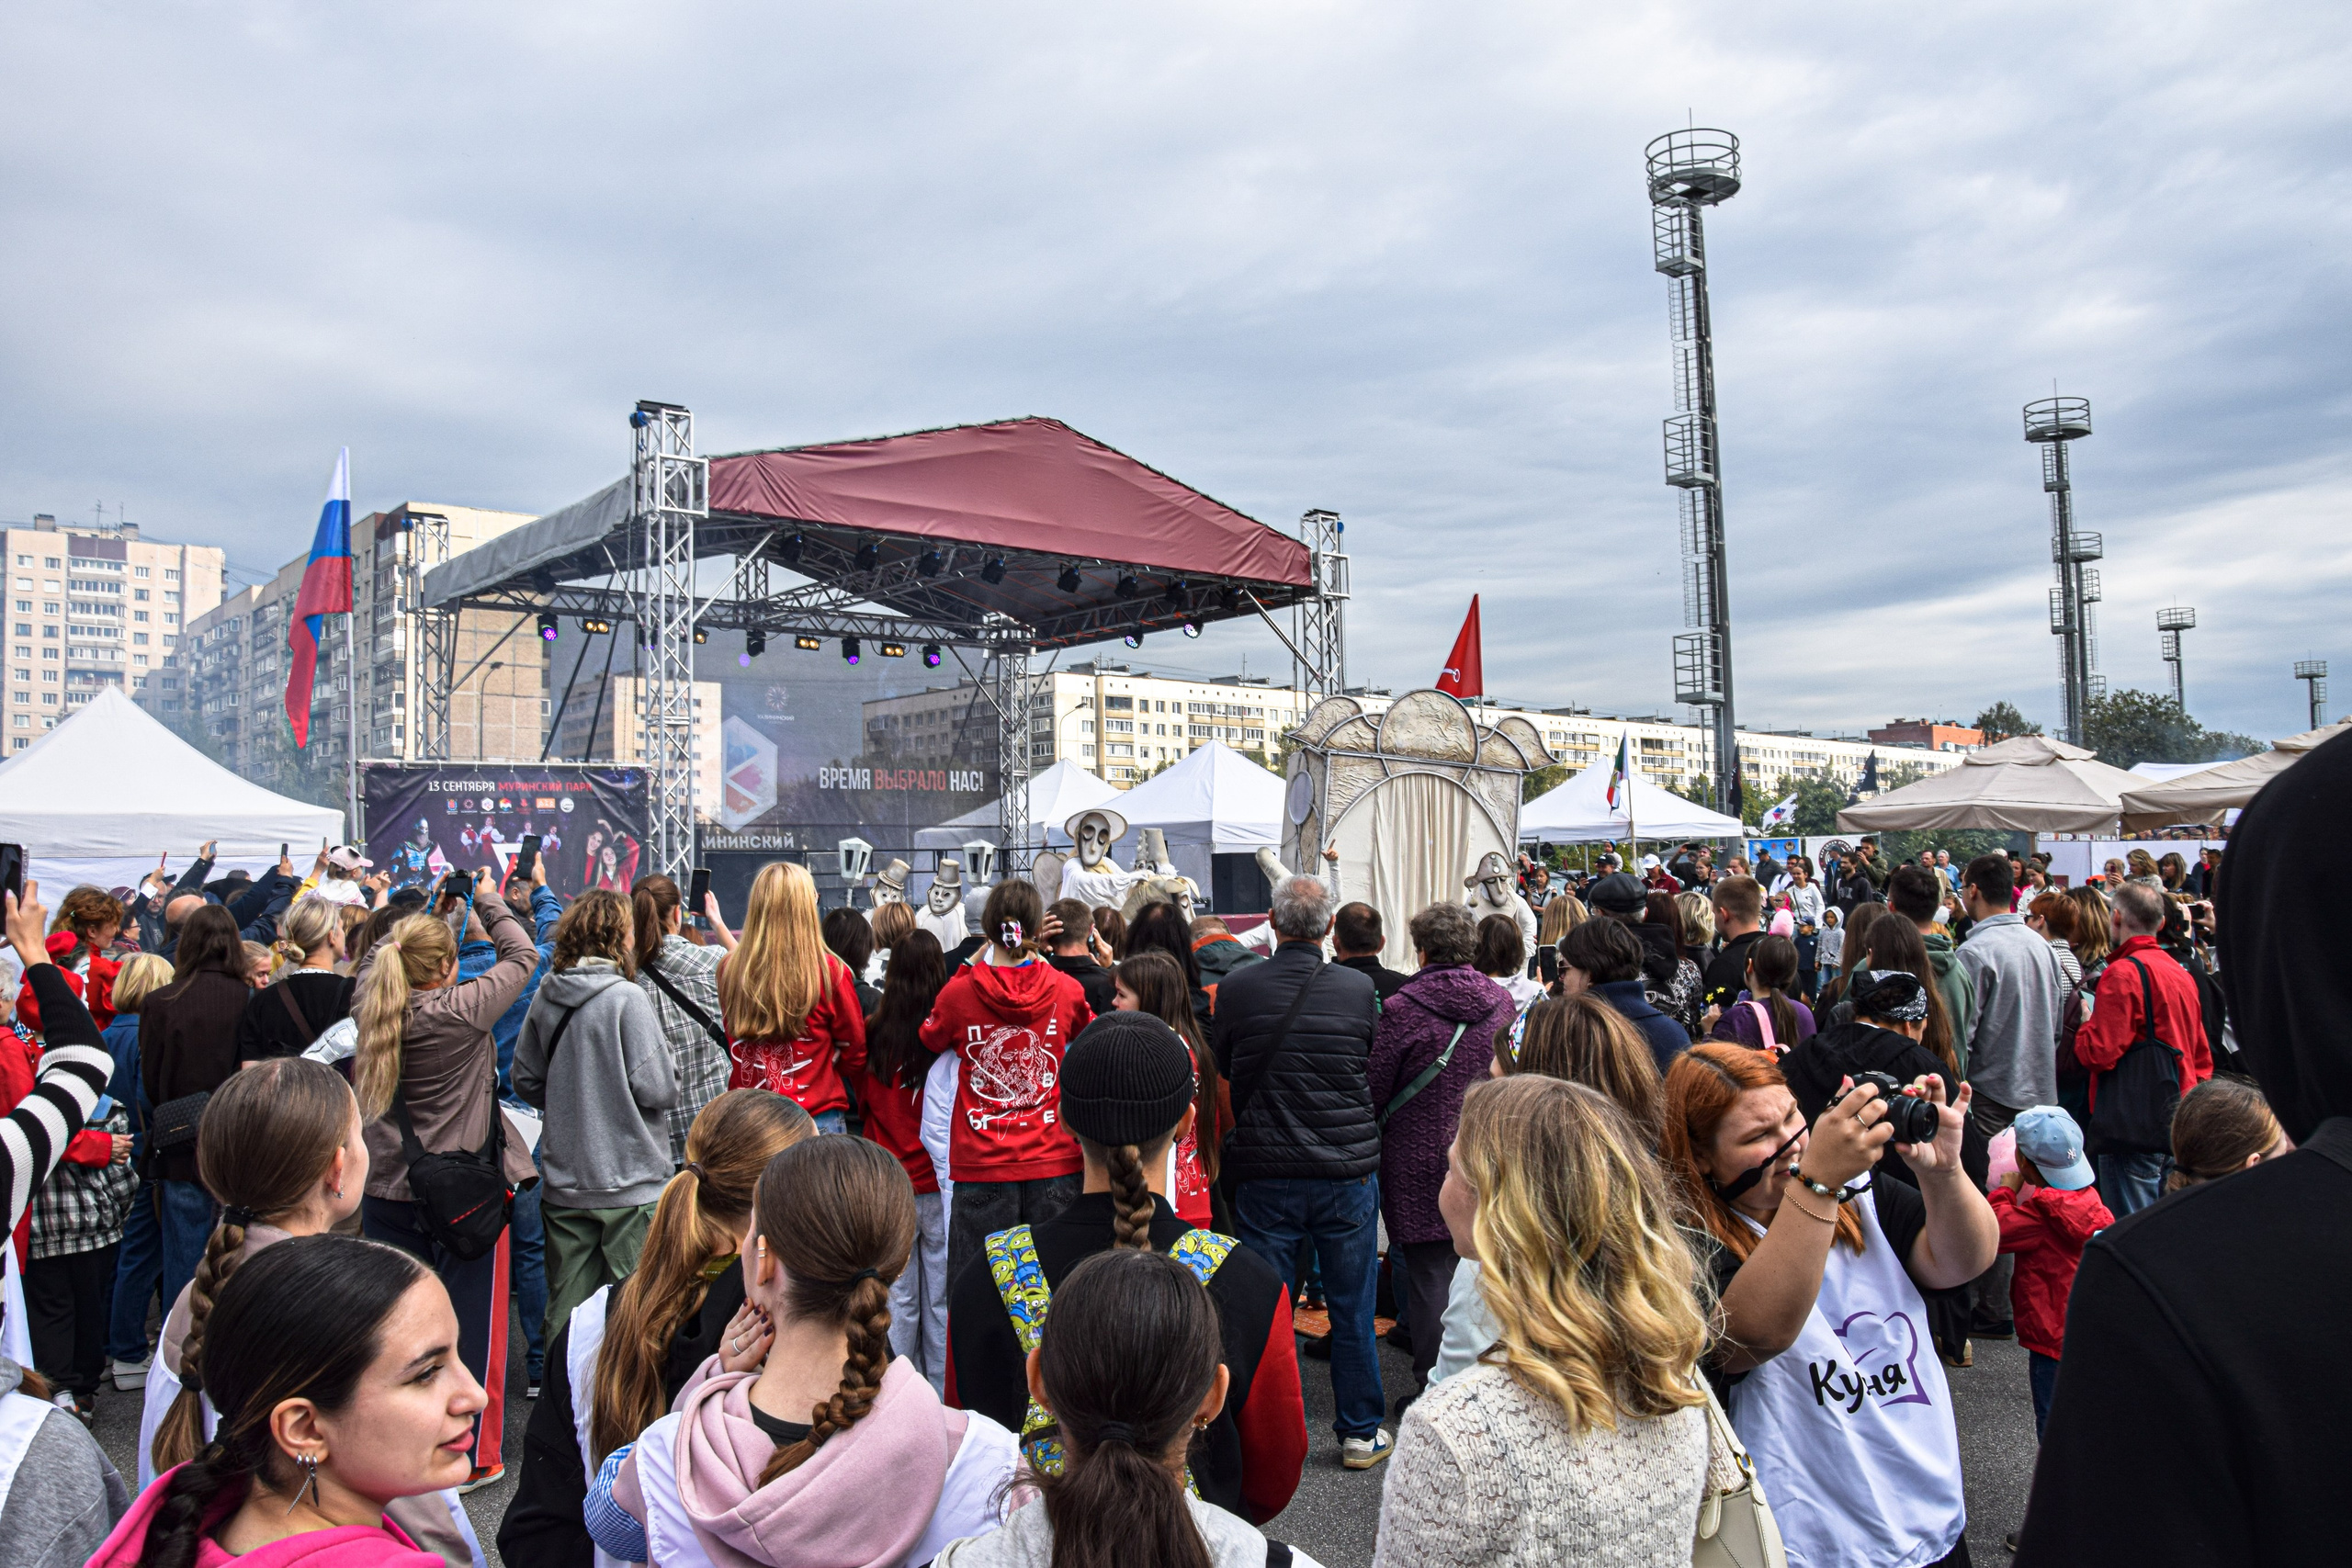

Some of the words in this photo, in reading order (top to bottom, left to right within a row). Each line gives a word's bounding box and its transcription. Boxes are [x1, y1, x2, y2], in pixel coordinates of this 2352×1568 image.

[428, 781, 440, 791] 13
[443, 780, 495, 791] СЕНТЯБРЯ
[498, 781, 561, 791] МУРИНСКИЙ
[820, 767, 871, 790] ВРЕМЯ
[875, 770, 946, 791] ВЫБРАЛО
[950, 772, 984, 792] НАС!
[967, 1025, 981, 1041] П
